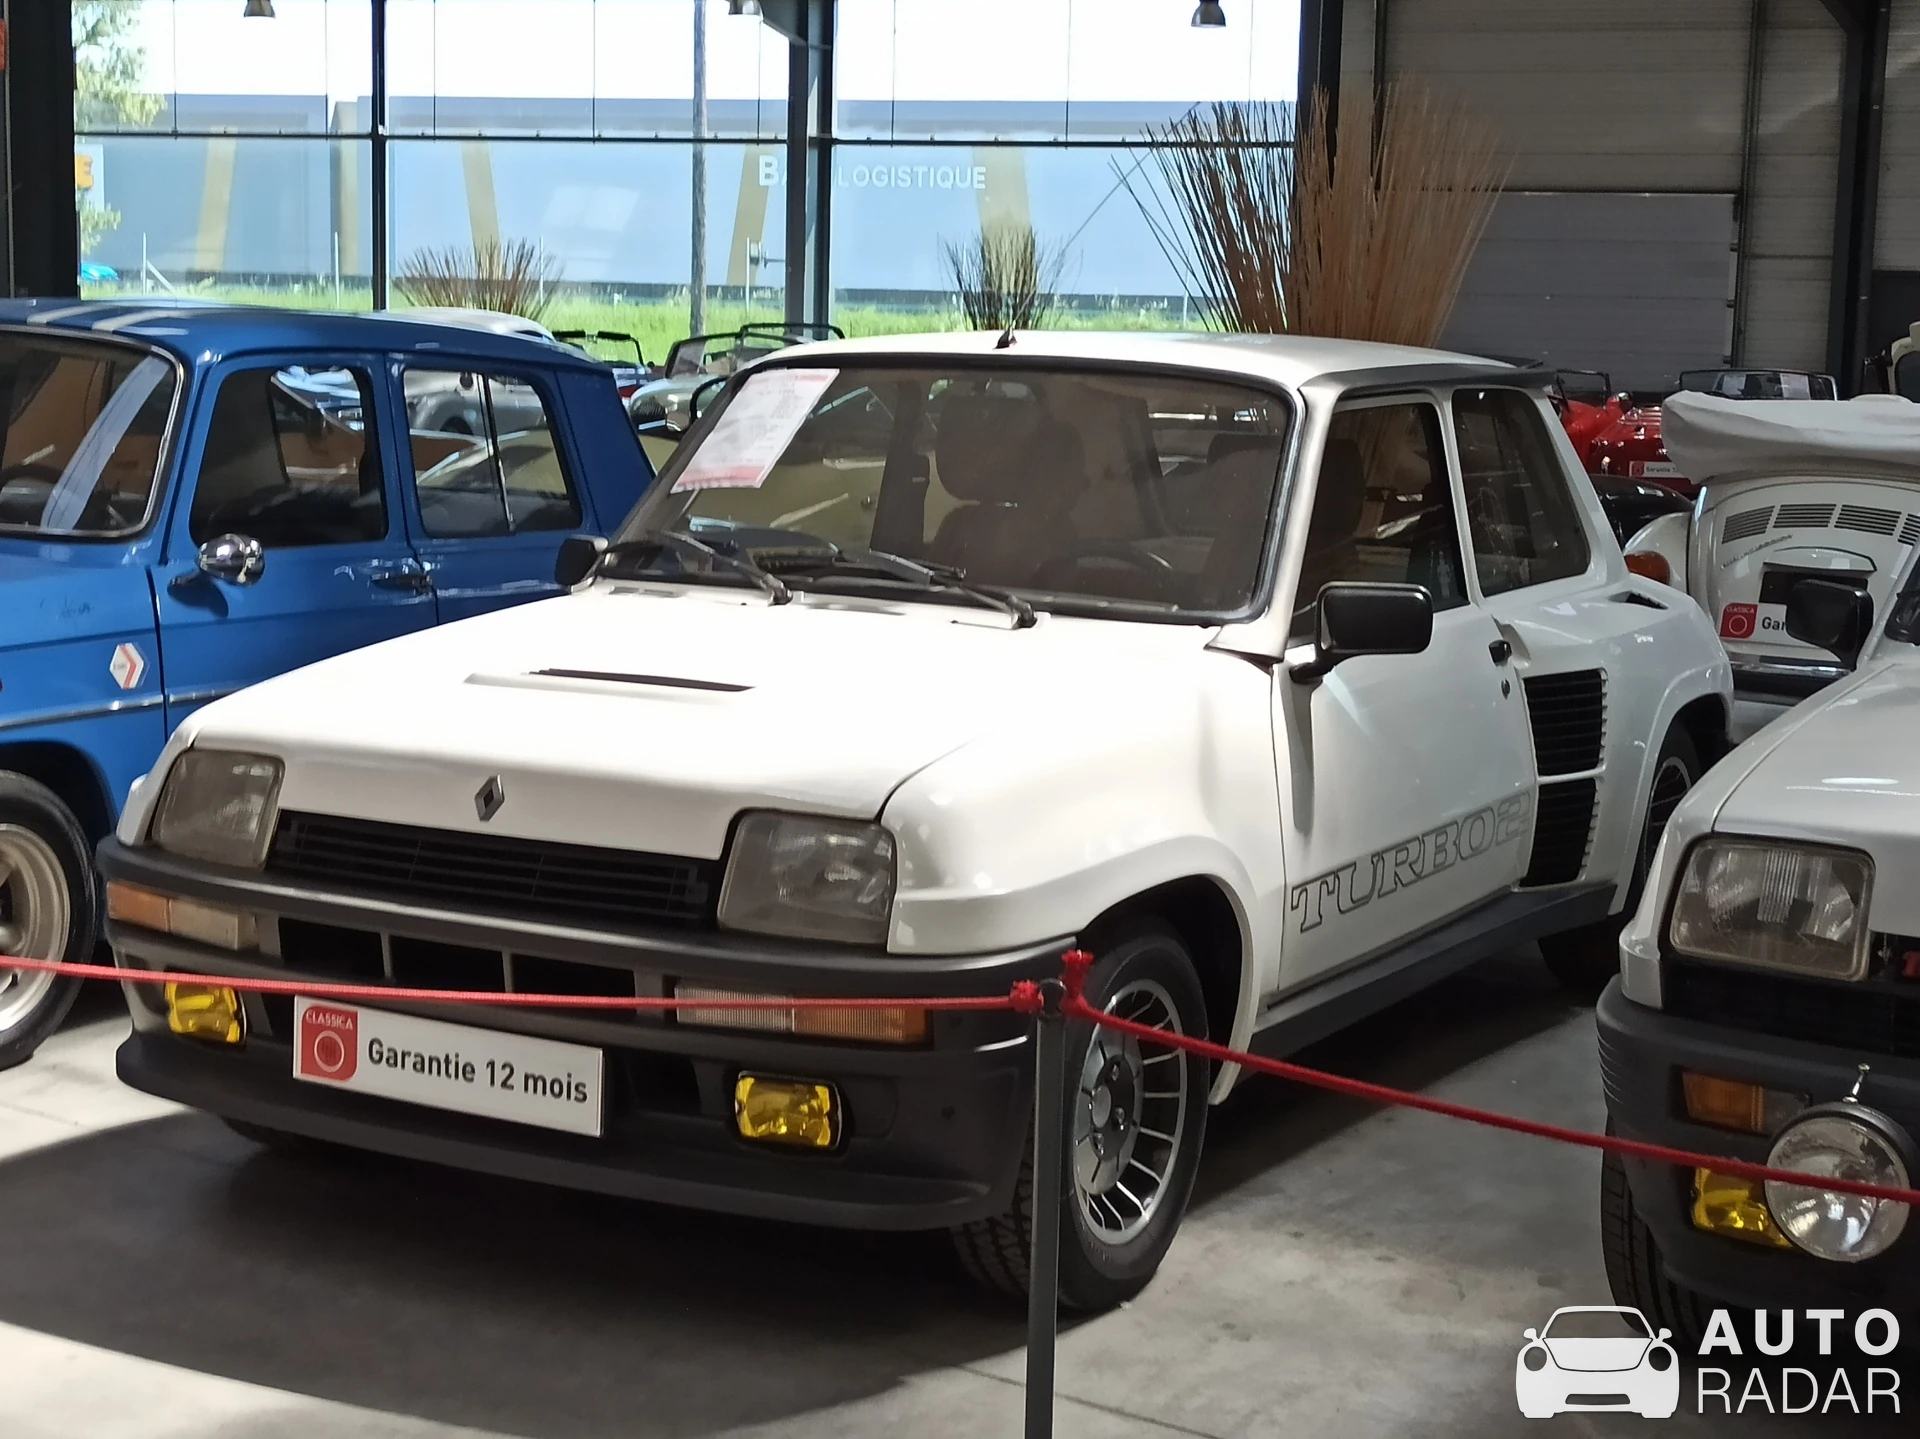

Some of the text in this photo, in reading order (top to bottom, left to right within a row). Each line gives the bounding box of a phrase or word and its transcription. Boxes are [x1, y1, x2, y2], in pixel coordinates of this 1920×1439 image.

[837, 164, 987, 190] LOGISTIQUE
[1761, 616, 1786, 631] Gar
[305, 1008, 354, 1031] CLASSICA
[367, 1036, 589, 1104] Garantie 12 mois
